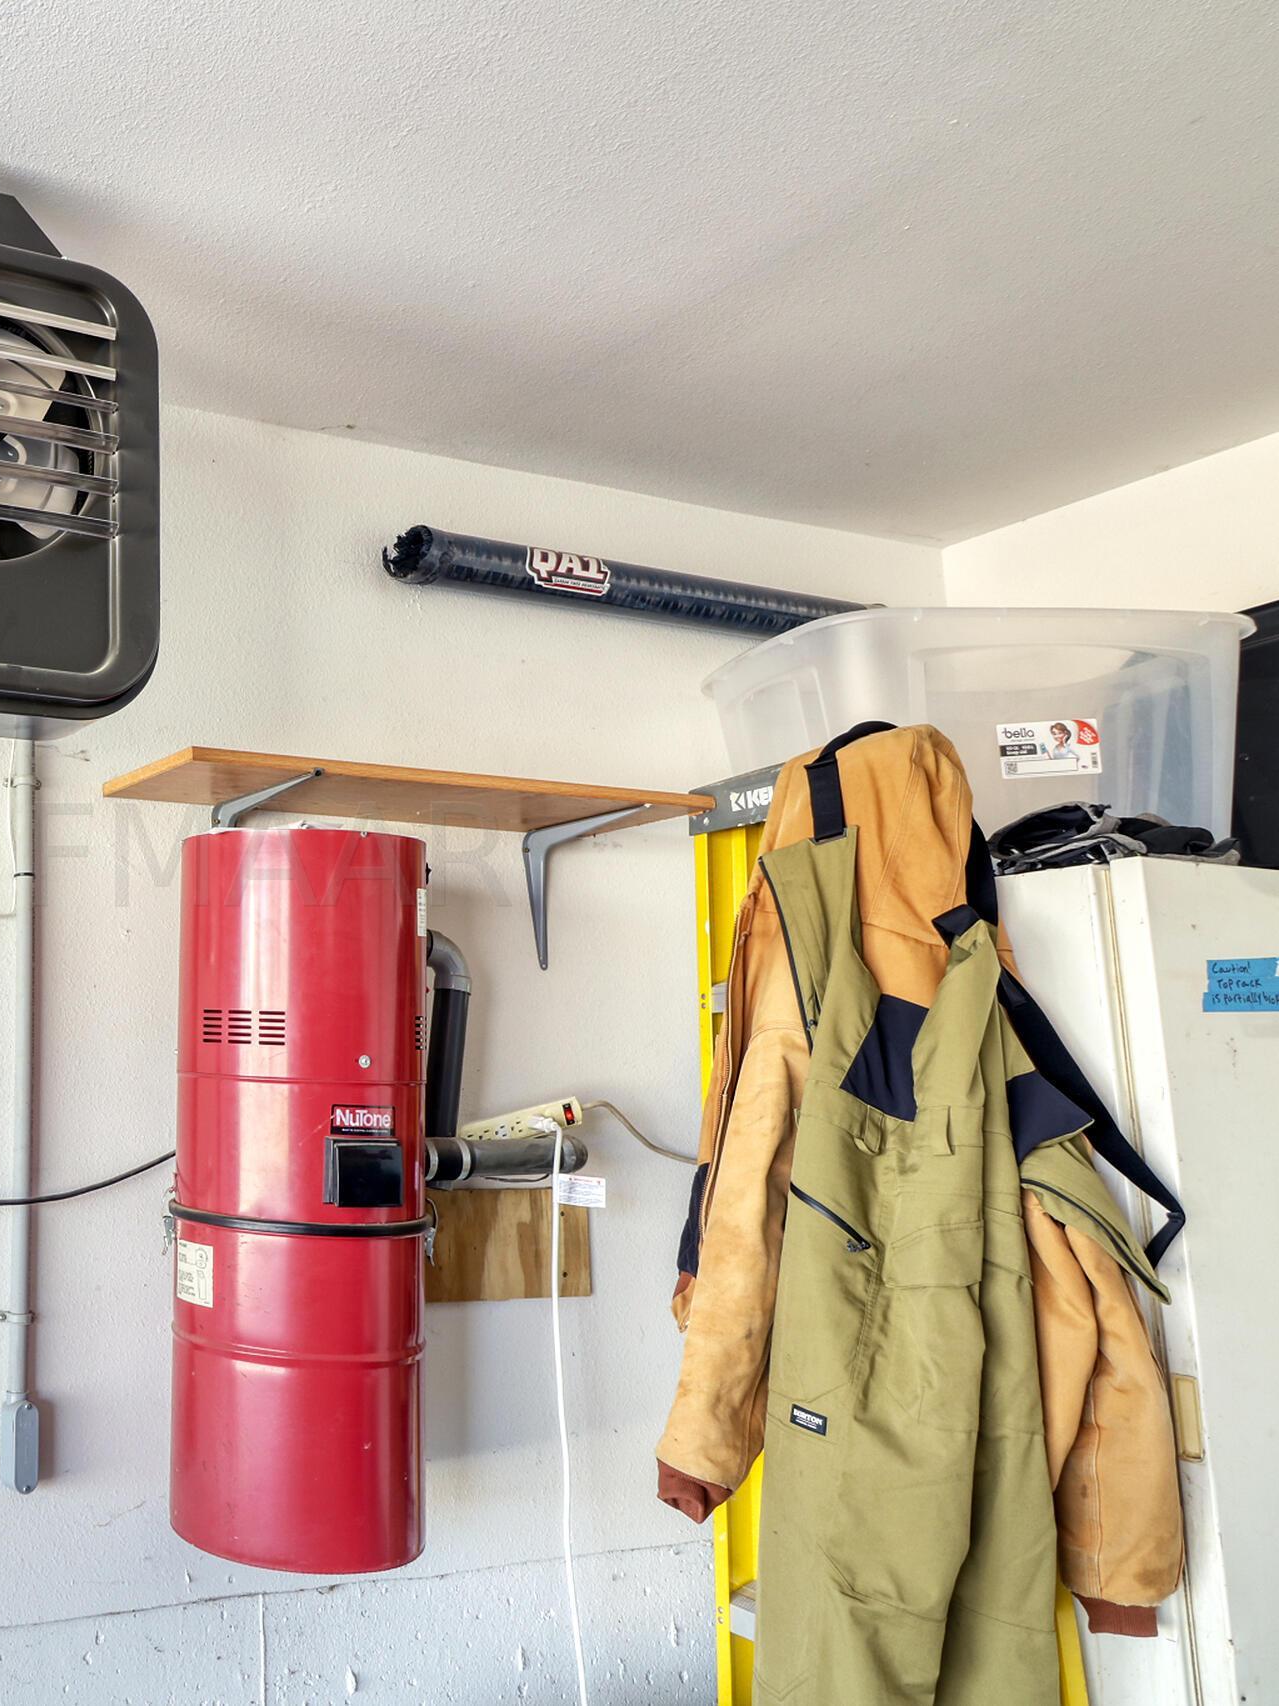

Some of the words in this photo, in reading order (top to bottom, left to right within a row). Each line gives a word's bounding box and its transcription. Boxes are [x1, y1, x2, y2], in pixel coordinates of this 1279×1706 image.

[532, 548, 605, 579] QA1
[1001, 727, 1035, 739] bella
[1236, 978, 1262, 989] rack
[335, 1108, 391, 1127] NuTone
